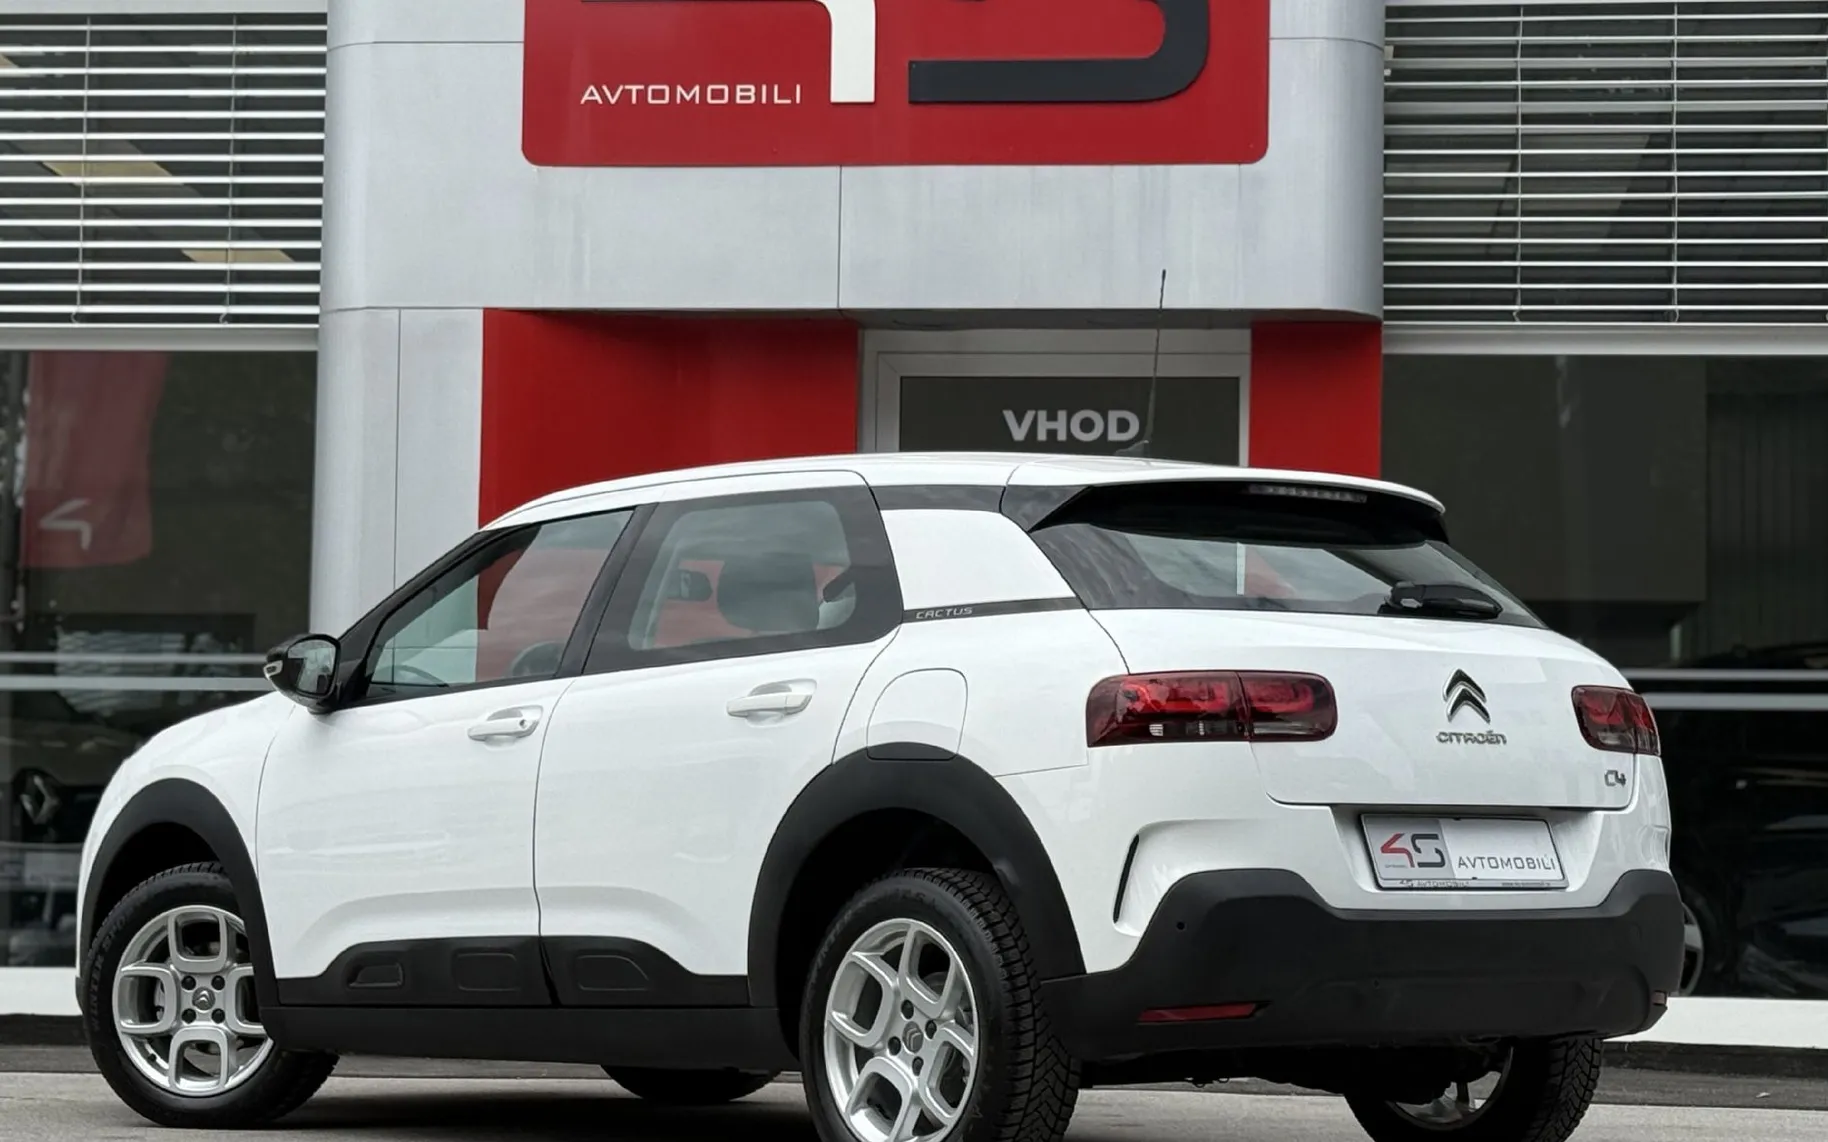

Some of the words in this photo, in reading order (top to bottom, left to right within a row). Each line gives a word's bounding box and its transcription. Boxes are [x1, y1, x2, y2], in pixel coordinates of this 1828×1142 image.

[580, 84, 802, 105] AVTOMOBILI
[1003, 409, 1140, 442] VHOD
[915, 607, 973, 619] CACTUS
[1604, 770, 1627, 788] C4
[1380, 833, 1446, 868] 4S
[1457, 856, 1556, 870] AVTOMOBILI
